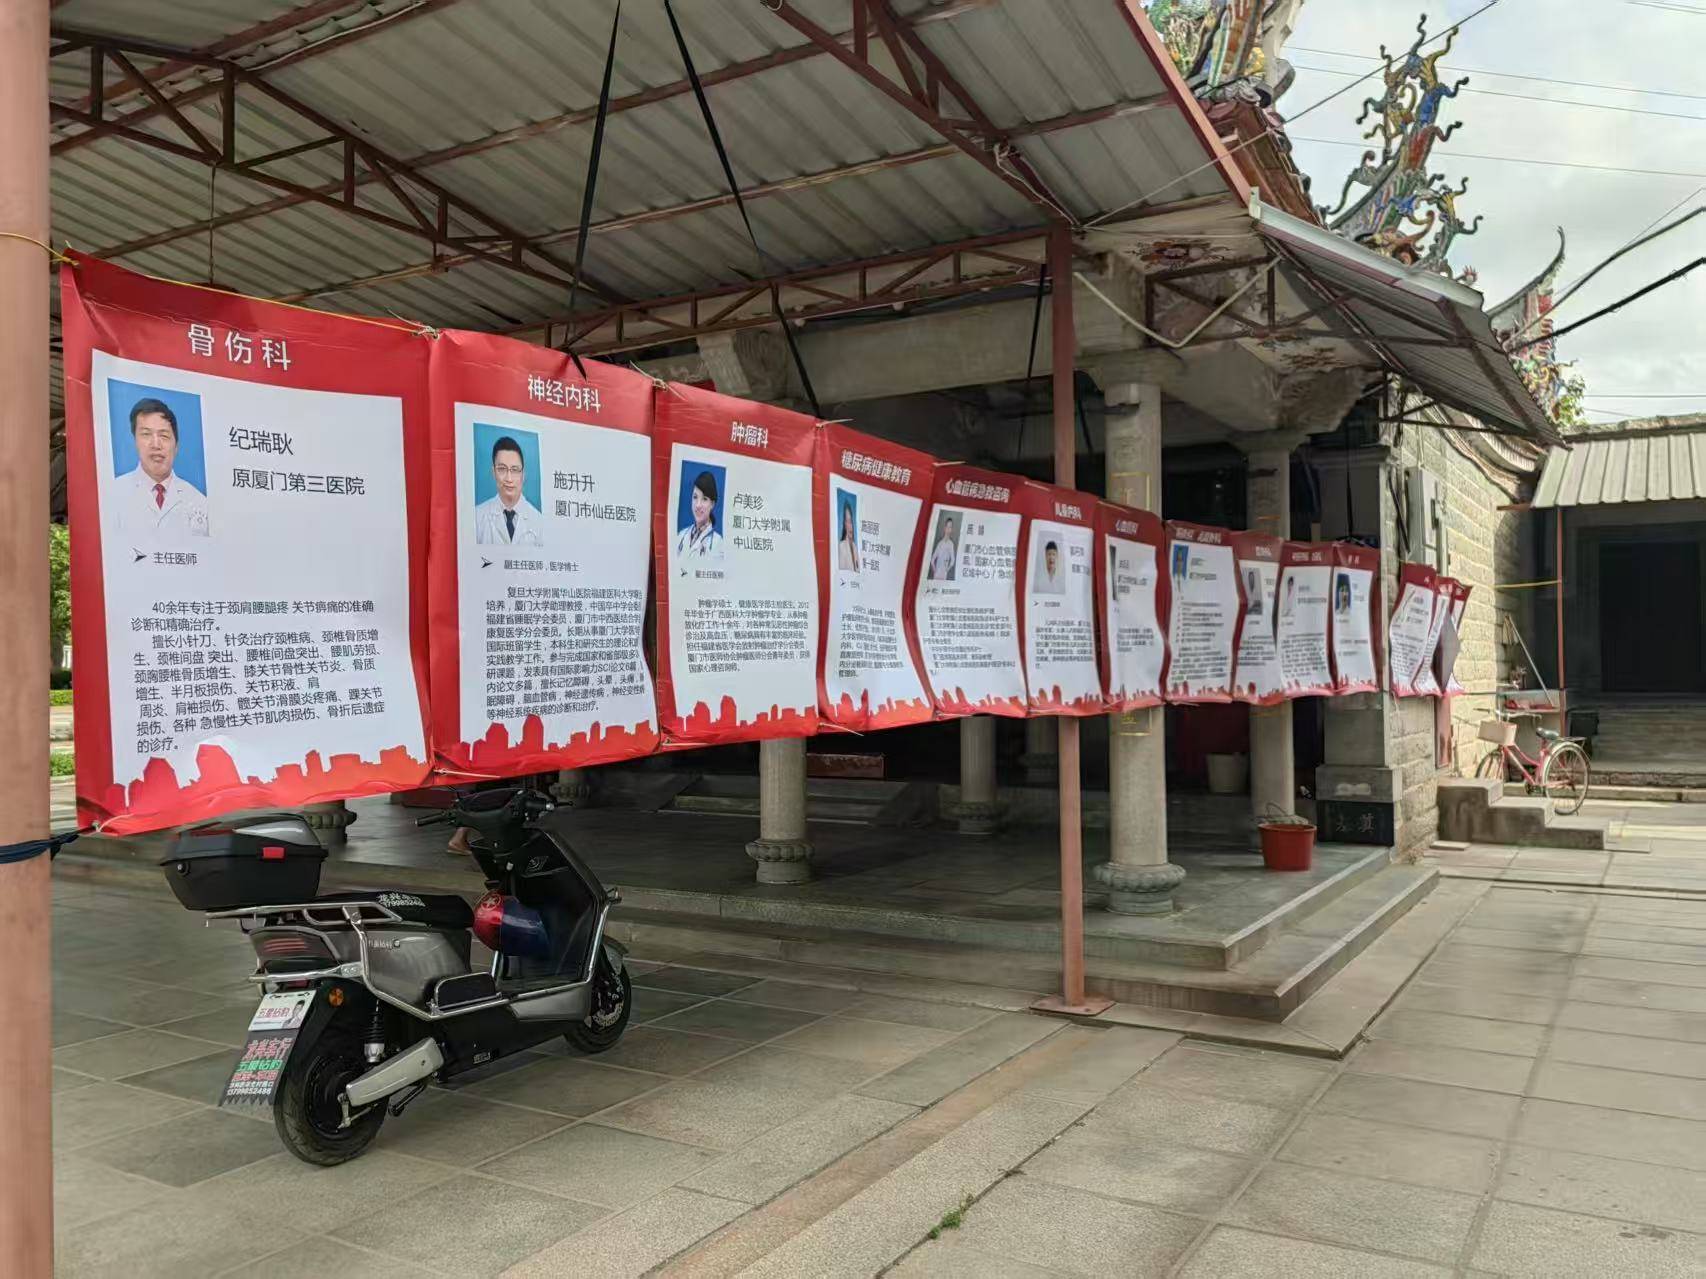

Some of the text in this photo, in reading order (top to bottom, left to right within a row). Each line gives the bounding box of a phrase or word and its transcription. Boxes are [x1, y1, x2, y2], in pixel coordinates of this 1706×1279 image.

[188, 323, 291, 371] 骨伤科
[528, 374, 601, 413] 神经内科
[229, 426, 294, 456] 纪瑞耿
[731, 421, 769, 448] 肿瘤科
[842, 449, 912, 486] 糖尿病健康教育
[232, 468, 365, 496] 原厦门第三医院
[553, 470, 595, 493] 施升升
[555, 499, 637, 523] 厦门市仙岳医院
[733, 493, 764, 511] 卢美珍
[732, 515, 791, 533] 厦门大学附属
[733, 536, 773, 551] 中山医院
[153, 552, 198, 566] 主任医师
[131, 618, 222, 633] 诊断和精确治疗。
[152, 629, 379, 649] 擅长小针刀、针灸治疗颈椎病、颈椎骨质增
[136, 676, 320, 701] 增生、半月板损伤、关节积液、肩
[137, 738, 179, 753] 的诊疗。
